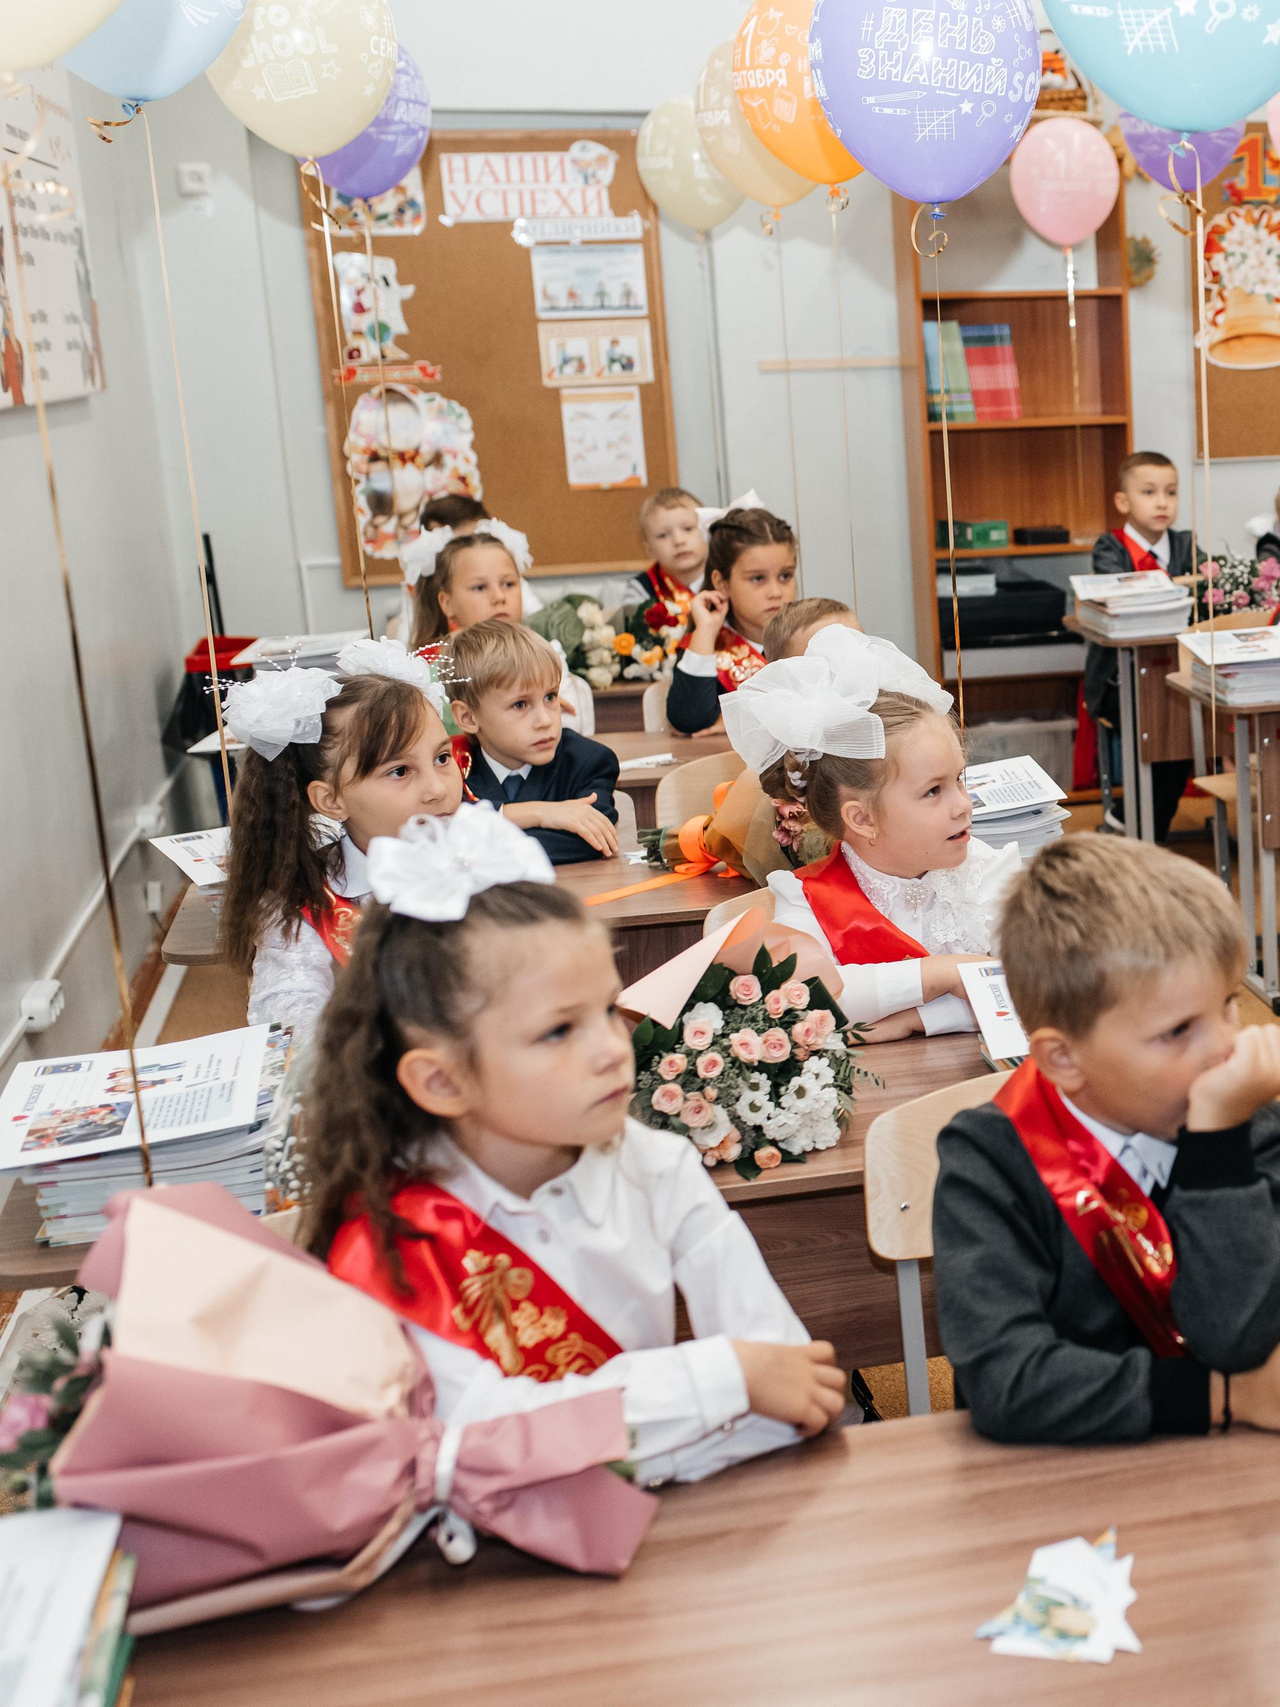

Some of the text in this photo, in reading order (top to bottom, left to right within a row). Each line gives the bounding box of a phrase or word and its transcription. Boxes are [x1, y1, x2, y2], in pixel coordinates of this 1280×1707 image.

[860, 6, 996, 55] #ДЕНЬ
[856, 47, 1008, 96] ЗНАНИЙ
[447, 154, 568, 185] НАШИ
[450, 187, 606, 219] УСПЕХИ
